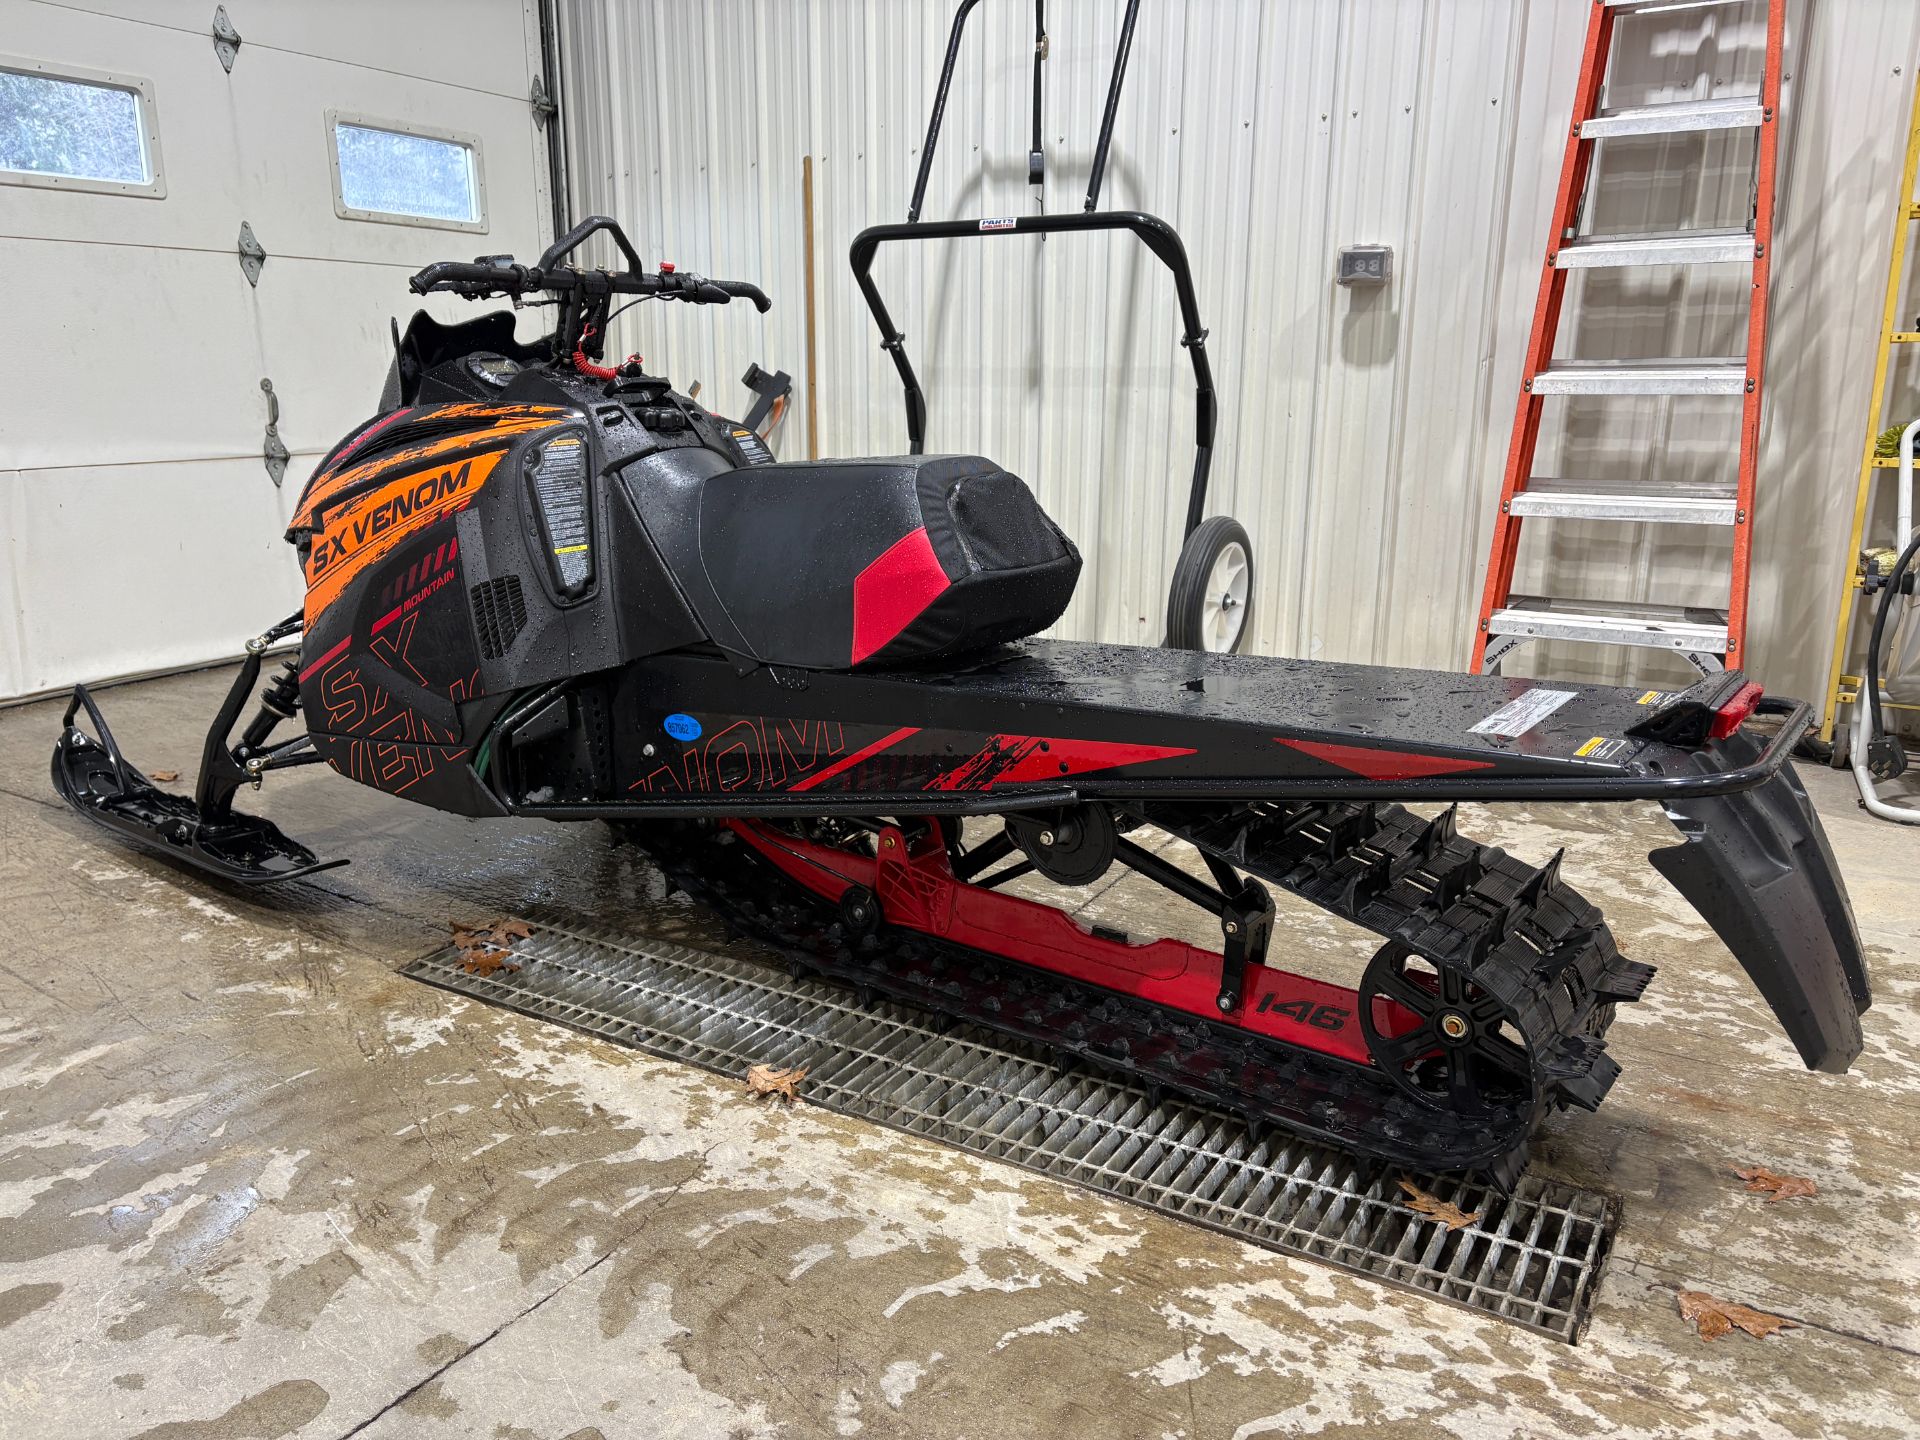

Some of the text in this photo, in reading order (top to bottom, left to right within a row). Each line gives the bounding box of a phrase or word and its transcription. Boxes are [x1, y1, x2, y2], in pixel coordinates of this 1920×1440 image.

[313, 527, 348, 576] SX
[352, 462, 472, 545] VENOM
[403, 568, 455, 612] MOUNTAIN
[1486, 639, 1518, 665] SHOX
[1688, 653, 1712, 677] SHO
[1256, 992, 1352, 1031] 146
